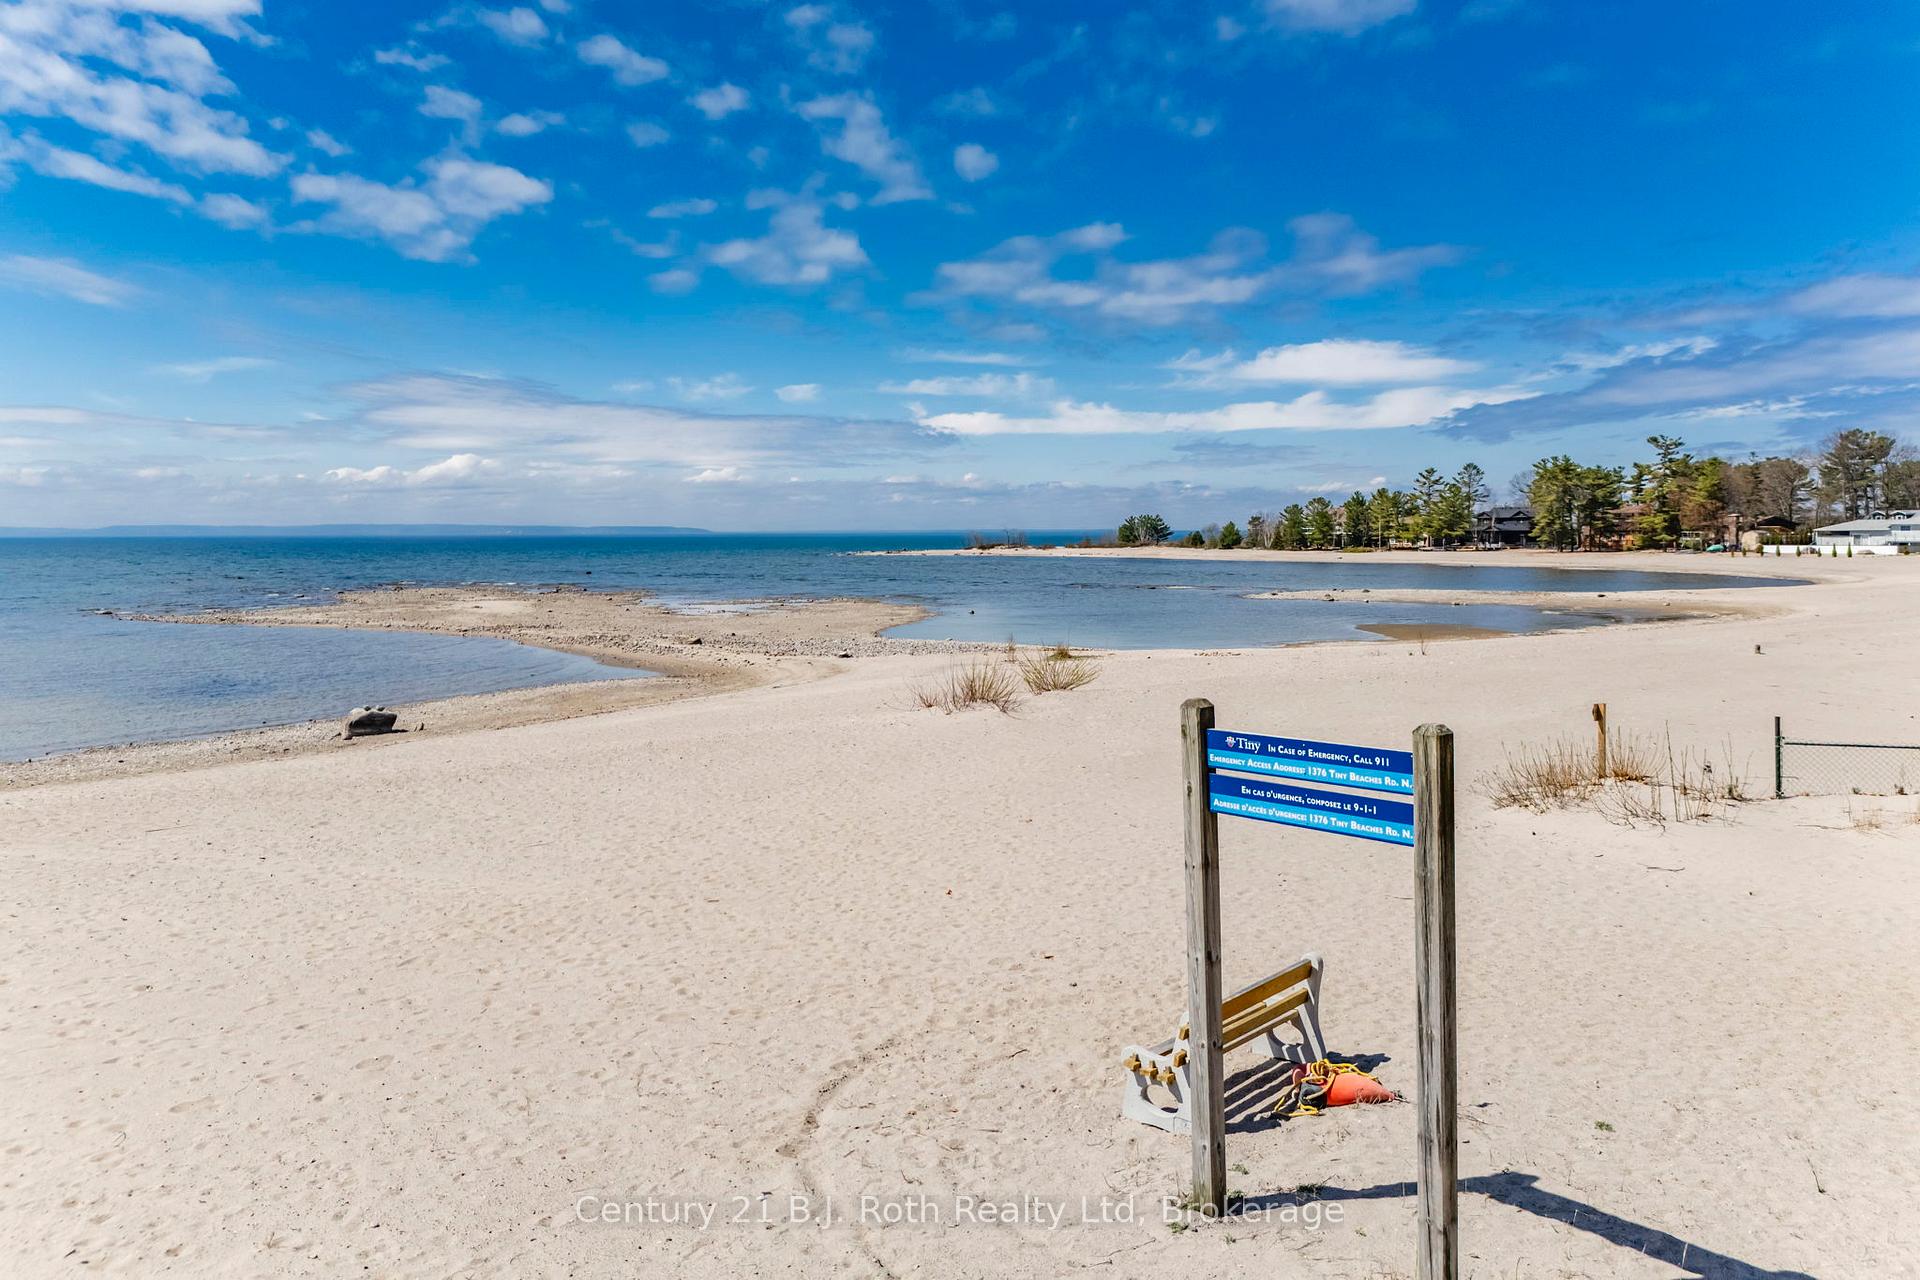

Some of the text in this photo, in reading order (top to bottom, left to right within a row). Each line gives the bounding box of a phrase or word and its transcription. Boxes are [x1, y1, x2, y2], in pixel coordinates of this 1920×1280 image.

[1236, 738, 1260, 754] Tiny
[1375, 757, 1389, 766] 911
[1308, 767, 1326, 777] 1376
[1354, 803, 1376, 814] 9-1-1
[1310, 814, 1328, 824] 1376
